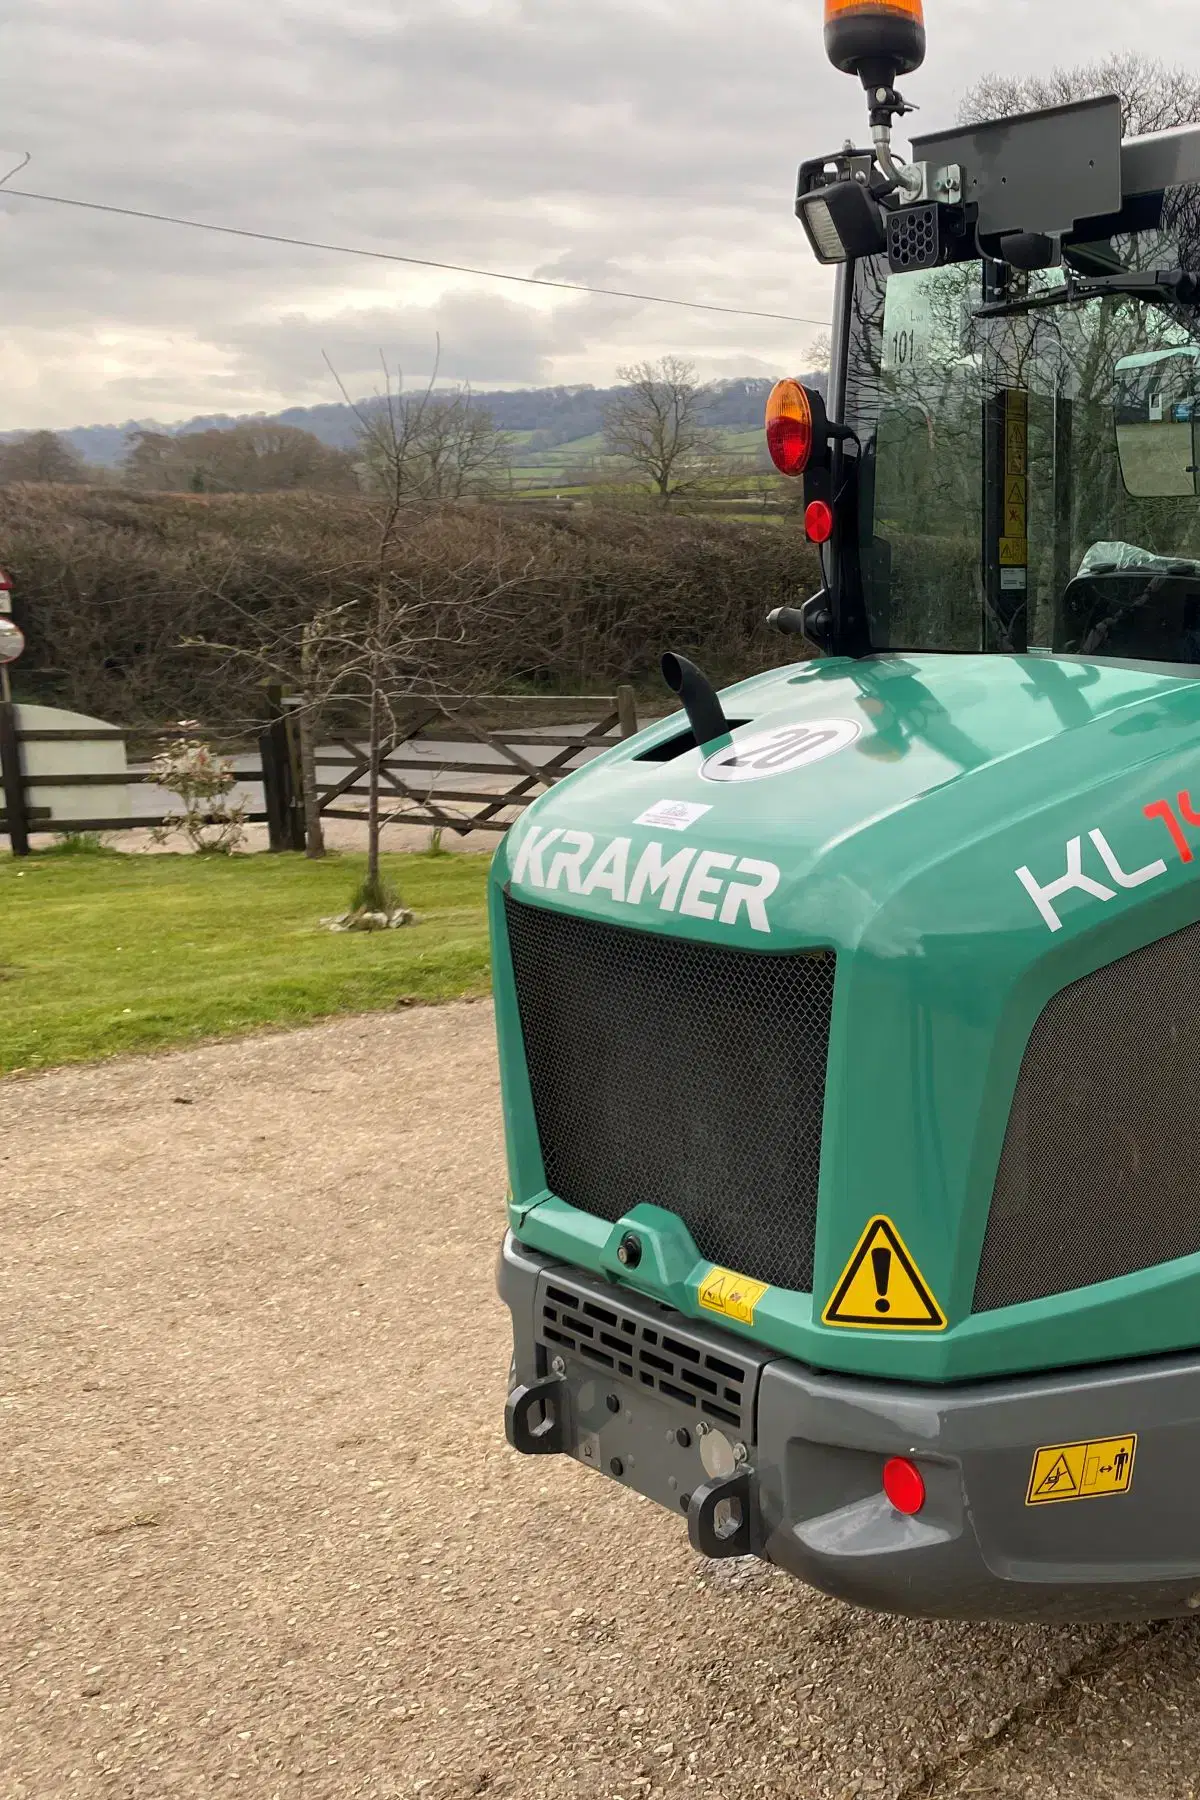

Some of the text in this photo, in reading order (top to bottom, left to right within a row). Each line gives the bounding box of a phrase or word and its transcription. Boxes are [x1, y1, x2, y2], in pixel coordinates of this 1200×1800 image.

[893, 328, 914, 364] 101
[717, 728, 839, 769] 20
[511, 826, 781, 934] KRAMER
